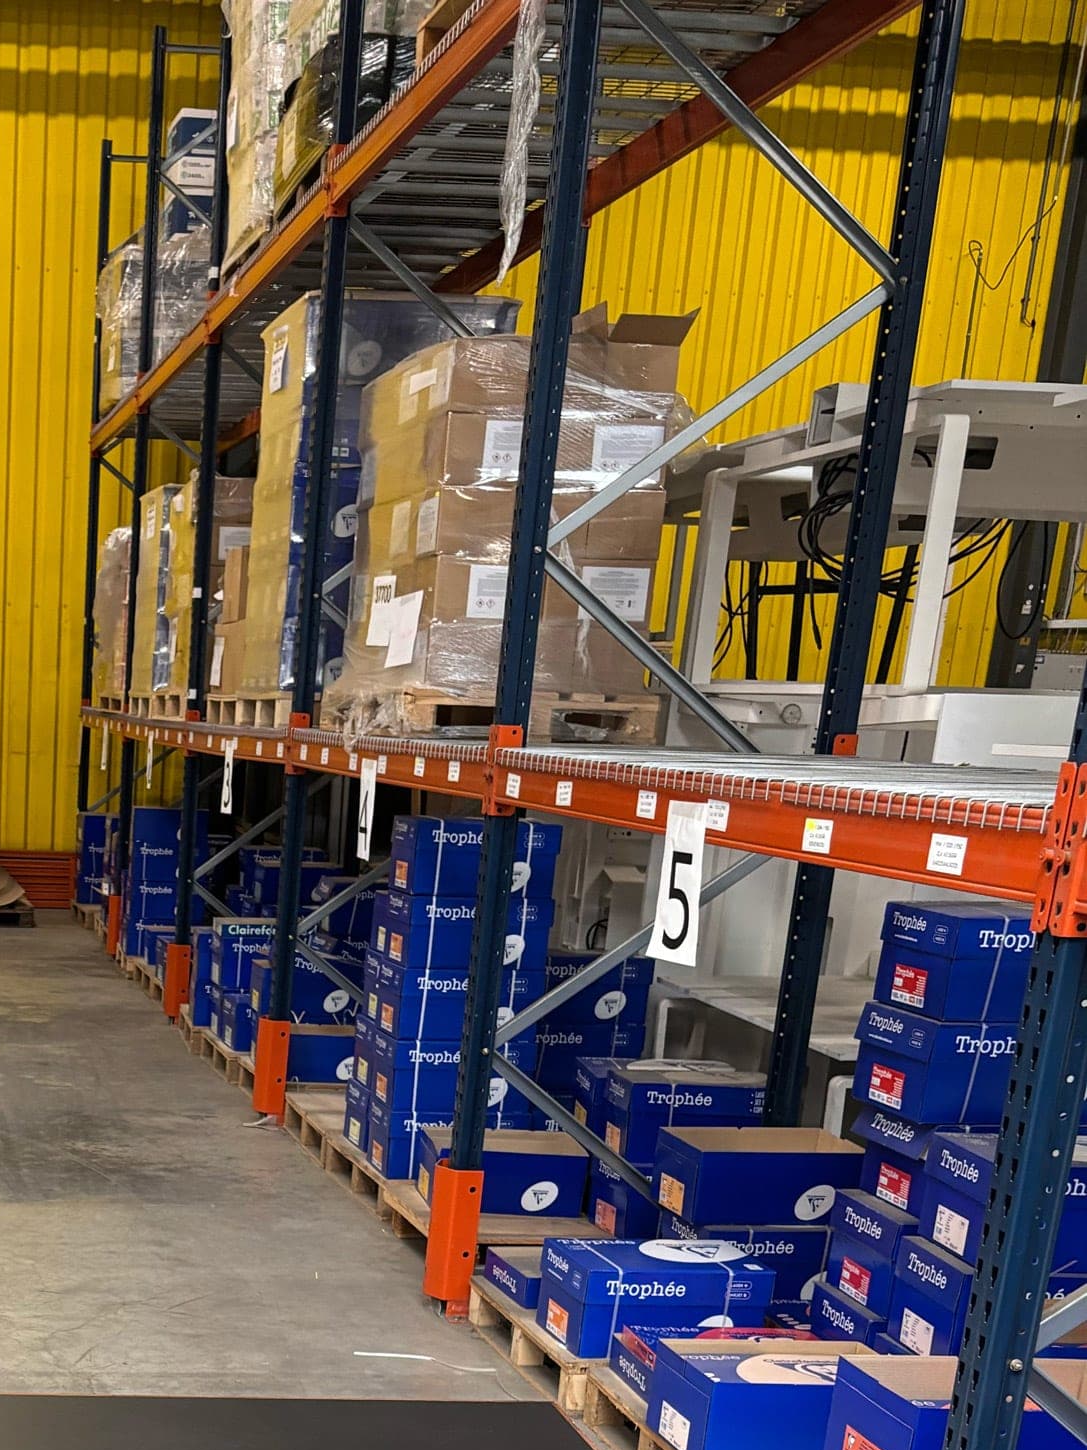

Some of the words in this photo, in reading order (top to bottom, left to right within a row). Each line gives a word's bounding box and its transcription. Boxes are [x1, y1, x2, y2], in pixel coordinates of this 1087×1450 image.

[661, 851, 693, 950] 5
[426, 904, 476, 921] Trophé
[893, 911, 927, 932] Trophée
[228, 924, 277, 936] Clairefo
[417, 976, 469, 993] Trophé
[869, 1012, 904, 1034] Trophée
[535, 1032, 583, 1046] rophée
[409, 1049, 461, 1065] Trophé
[647, 1090, 712, 1107] Trophée
[871, 1112, 915, 1142] Trophée
[940, 1149, 979, 1184] Trophée
[845, 1206, 882, 1240] Trophée
[547, 1248, 569, 1274] Trophée
[908, 1252, 947, 1290] Trophée
[606, 1280, 686, 1299] Trophée
[822, 1299, 855, 1335] Trophée
[618, 1354, 646, 1393] Trophée
